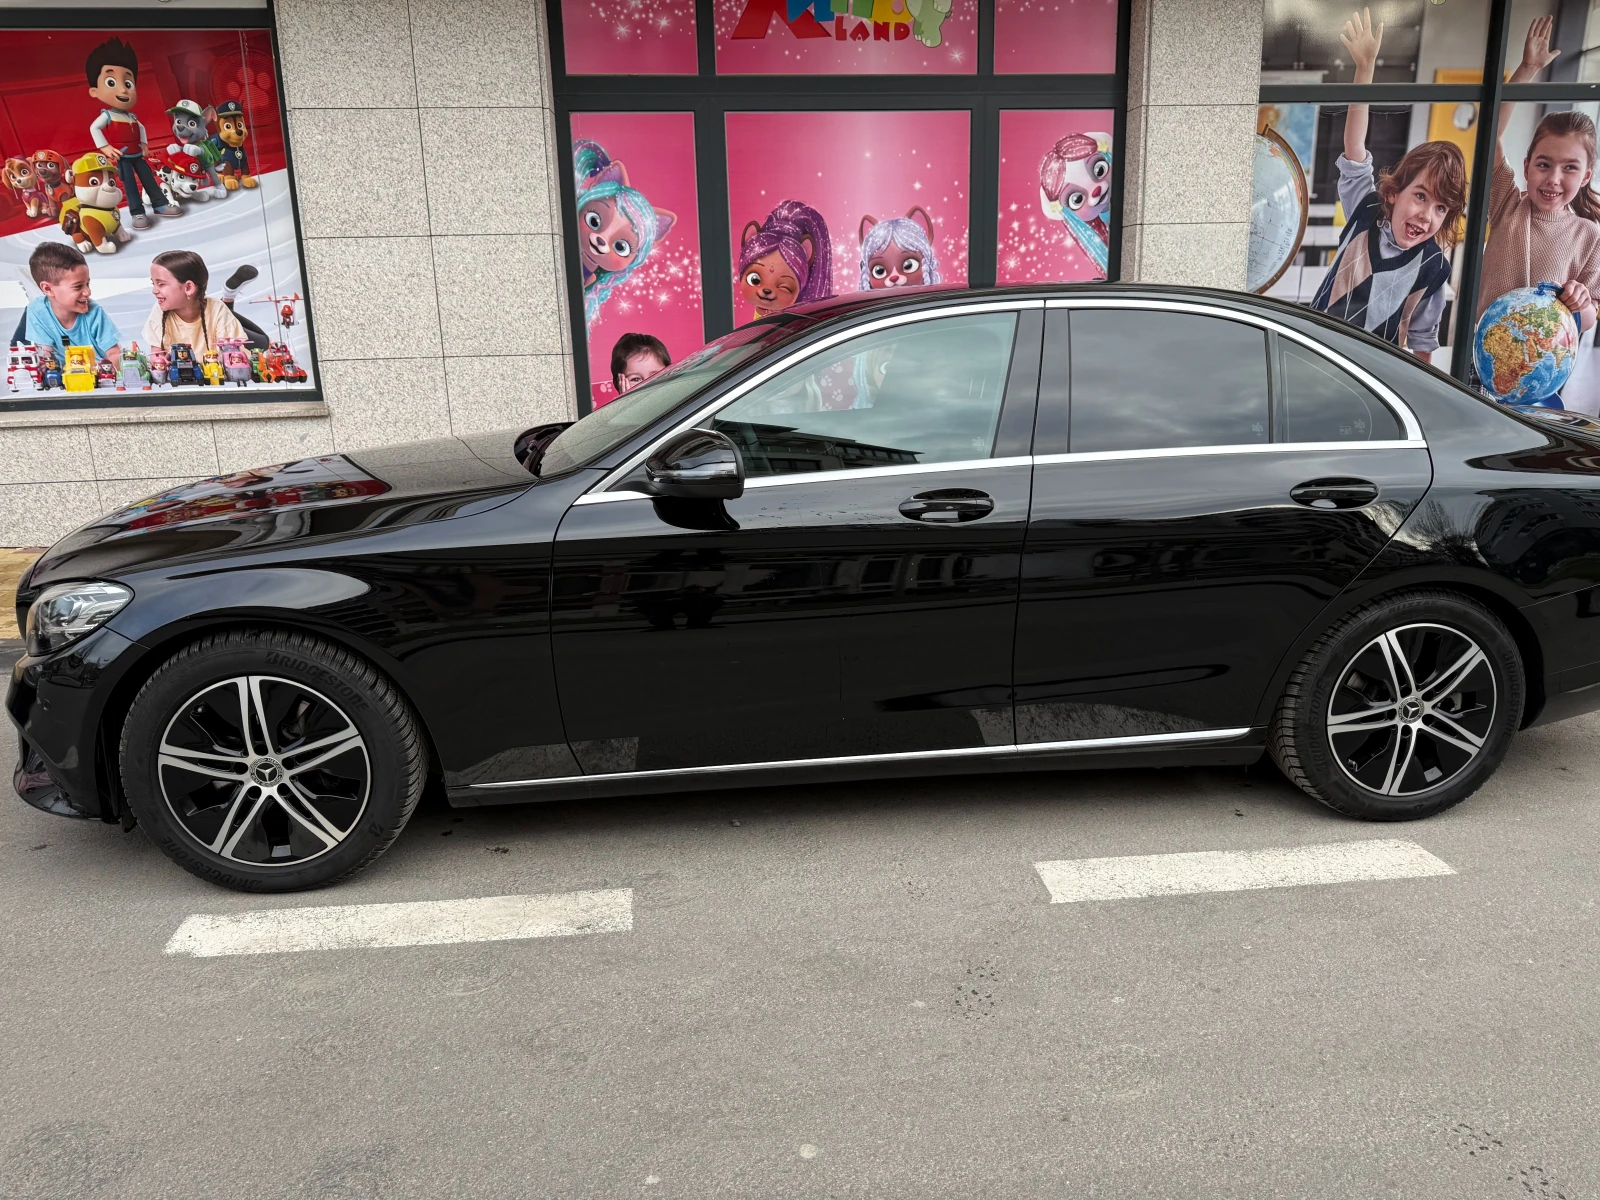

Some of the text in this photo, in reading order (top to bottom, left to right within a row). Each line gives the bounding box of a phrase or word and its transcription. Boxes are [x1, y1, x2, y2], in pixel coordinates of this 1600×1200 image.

[835, 16, 911, 42] LAND
[264, 651, 370, 713] BRIDGESTONE
[1501, 650, 1520, 741] BRIDGESTONE
[159, 836, 263, 893] BRIDGESTONE
